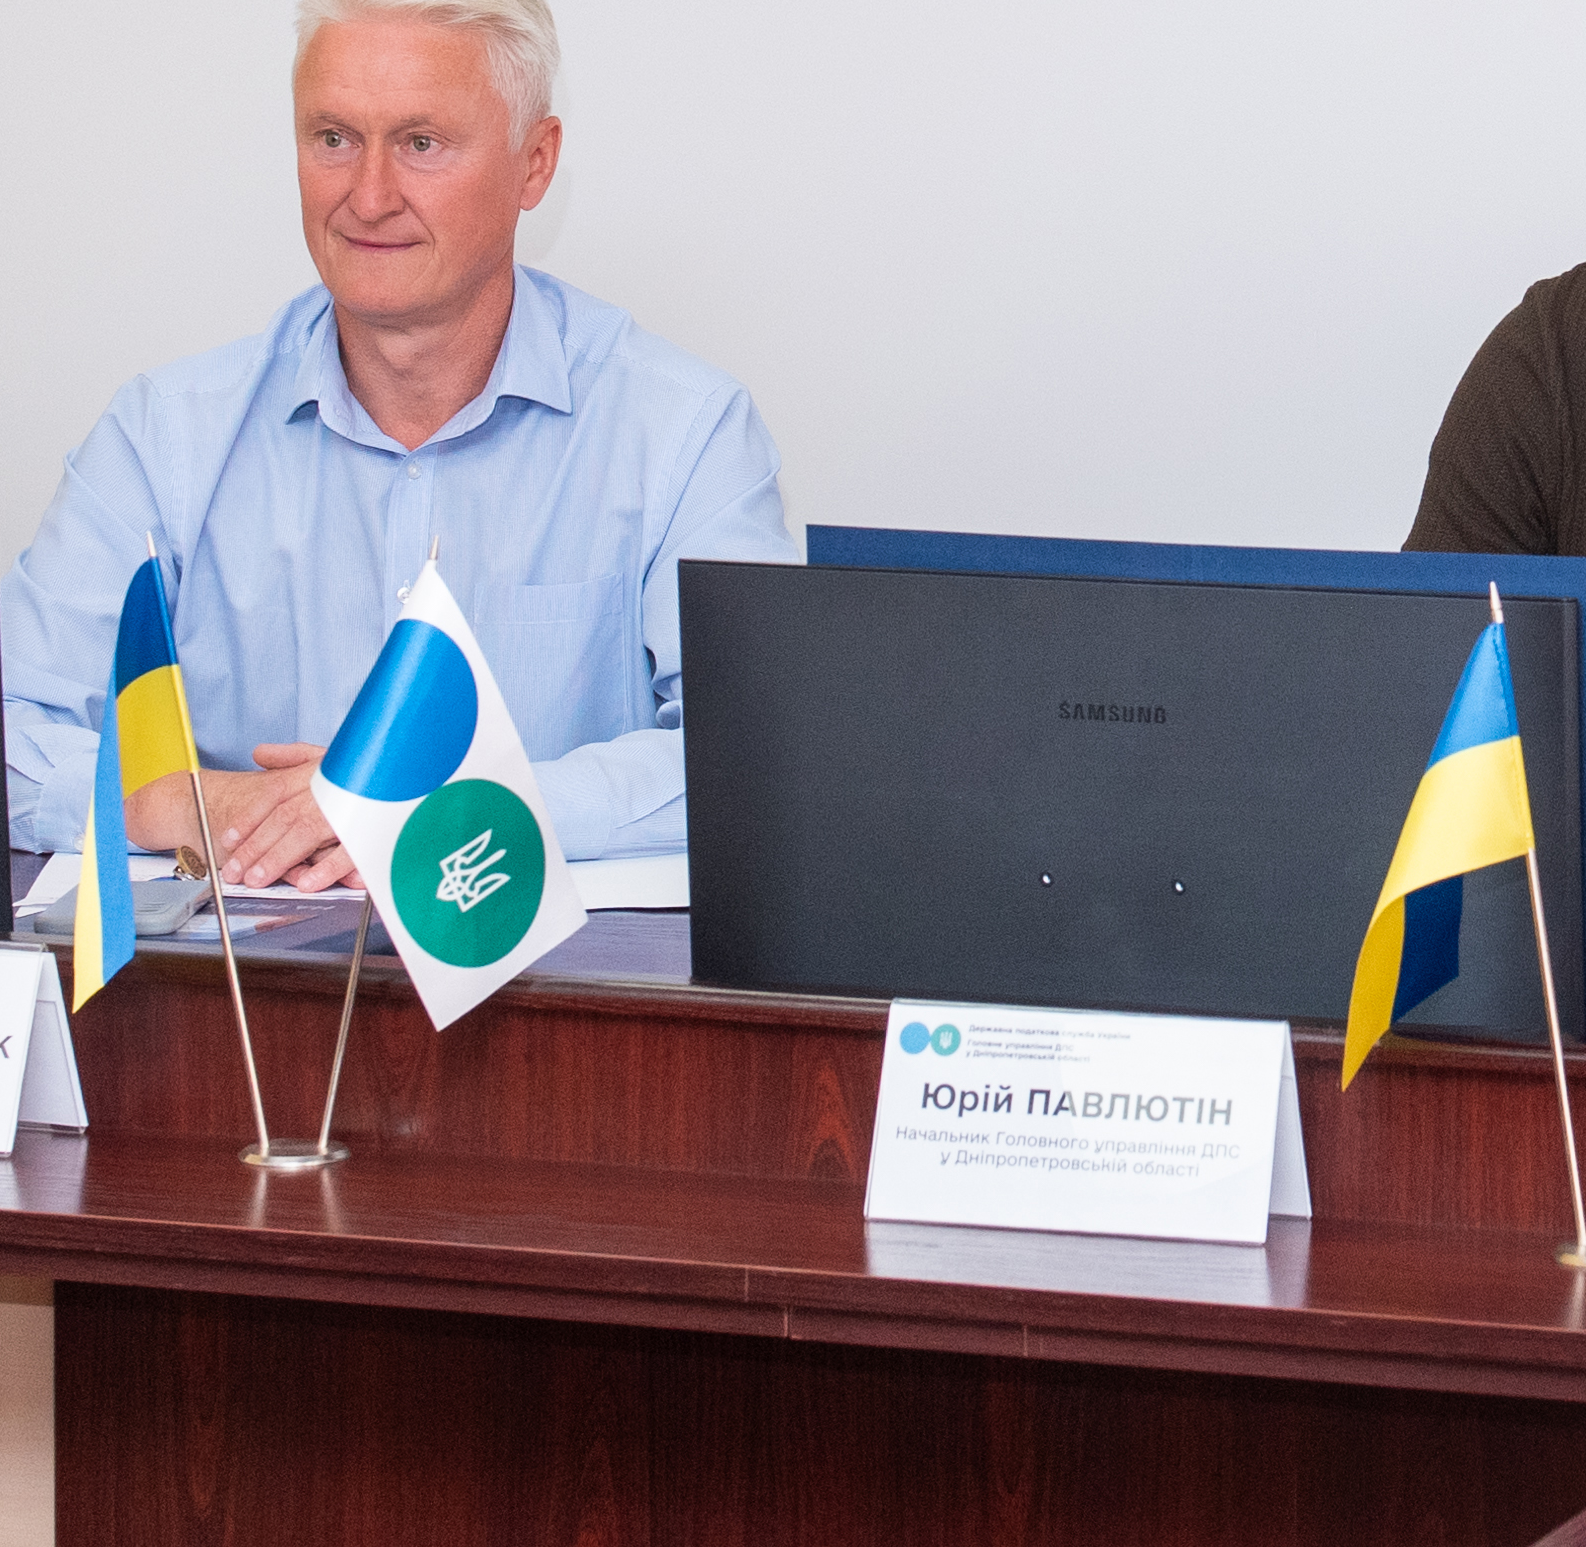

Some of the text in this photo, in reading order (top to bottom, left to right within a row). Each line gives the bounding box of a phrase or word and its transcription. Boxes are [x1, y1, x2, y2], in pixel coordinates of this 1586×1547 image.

[1058, 702, 1167, 724] SAMSUNG
[922, 1082, 1233, 1126] Юрій ПАВЛЮТІН
[896, 1126, 1240, 1159] Начальник Головного управління ДПС
[940, 1149, 1200, 1177] у Дніпропетровській області
